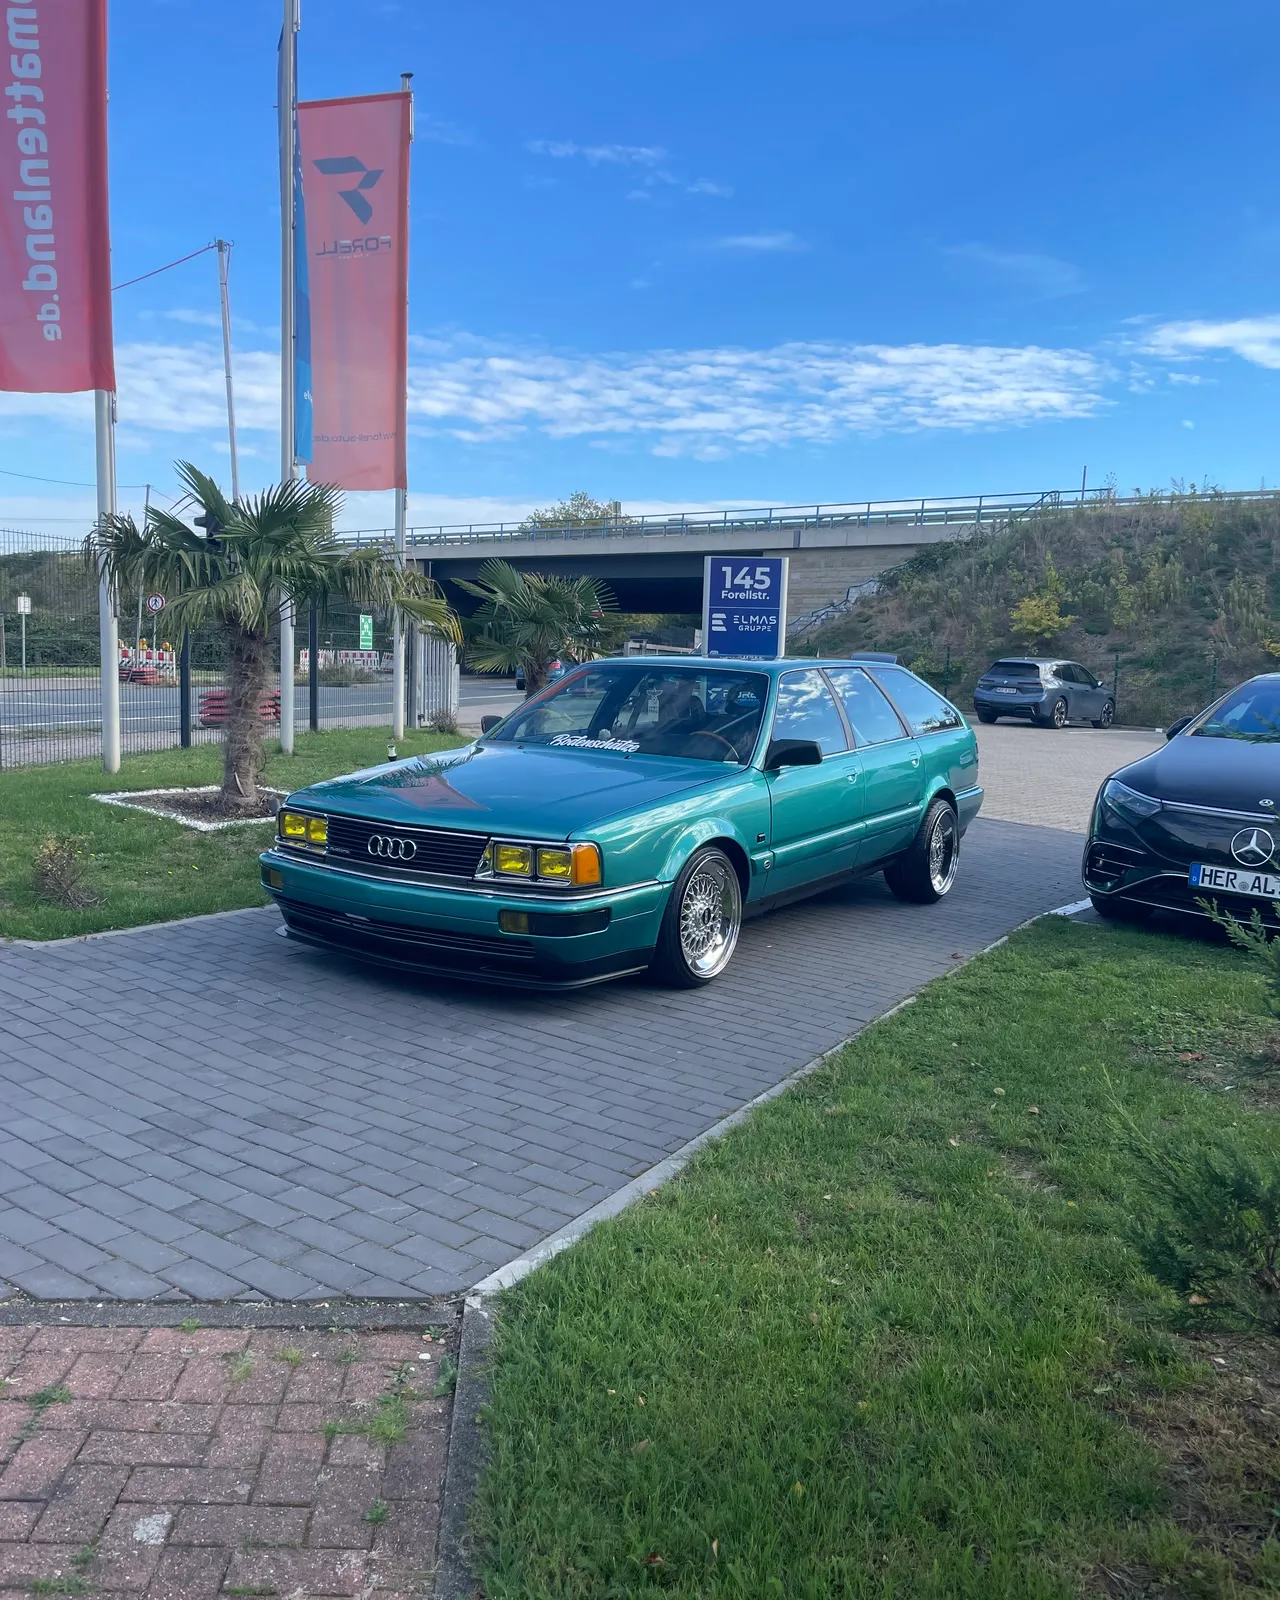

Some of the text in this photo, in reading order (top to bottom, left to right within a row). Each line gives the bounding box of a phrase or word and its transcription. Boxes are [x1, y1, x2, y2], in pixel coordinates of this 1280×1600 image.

[721, 566, 771, 590] 145
[721, 590, 770, 600] Forellstr.
[733, 615, 777, 625] ELMAS
[1201, 867, 1237, 889] HER
[1250, 875, 1275, 895] AL
